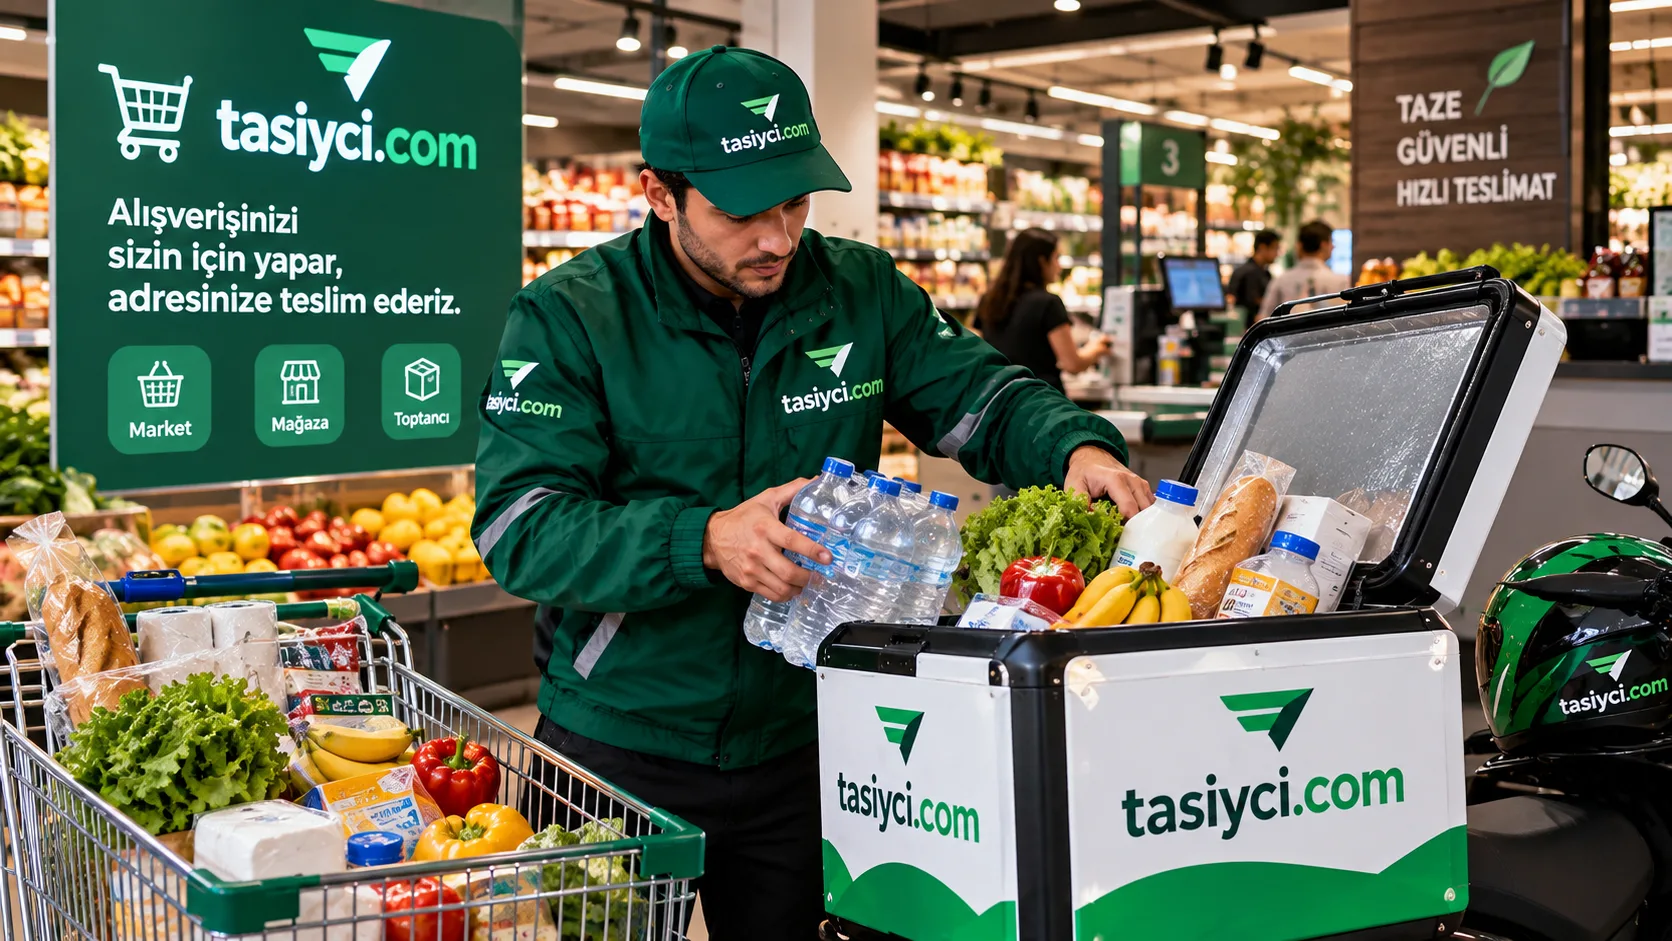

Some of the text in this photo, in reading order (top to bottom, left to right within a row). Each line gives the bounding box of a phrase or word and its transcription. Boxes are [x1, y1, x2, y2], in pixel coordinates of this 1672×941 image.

[1396, 91, 1462, 123] TAZE
[216, 100, 476, 172] tasiyci.com
[721, 122, 809, 154] tasiyci.com
[1397, 124, 1508, 165] GÜVENLİ
[1161, 139, 1180, 176] 3
[1397, 169, 1556, 207] HIZLI TESLİMAT
[108, 198, 298, 236] Alışverişinizi
[108, 239, 343, 280] sizin için yapar,
[108, 283, 461, 315] adresinize teslim ederiz.
[781, 376, 883, 414] tasiyci.com
[130, 420, 192, 439] Market
[271, 415, 329, 434] Mağaza
[394, 412, 450, 429] Toptancı
[1558, 678, 1668, 714] tasiyci.com
[838, 773, 979, 842] tasiyci.com
[1122, 766, 1404, 840] tasiyci.com
